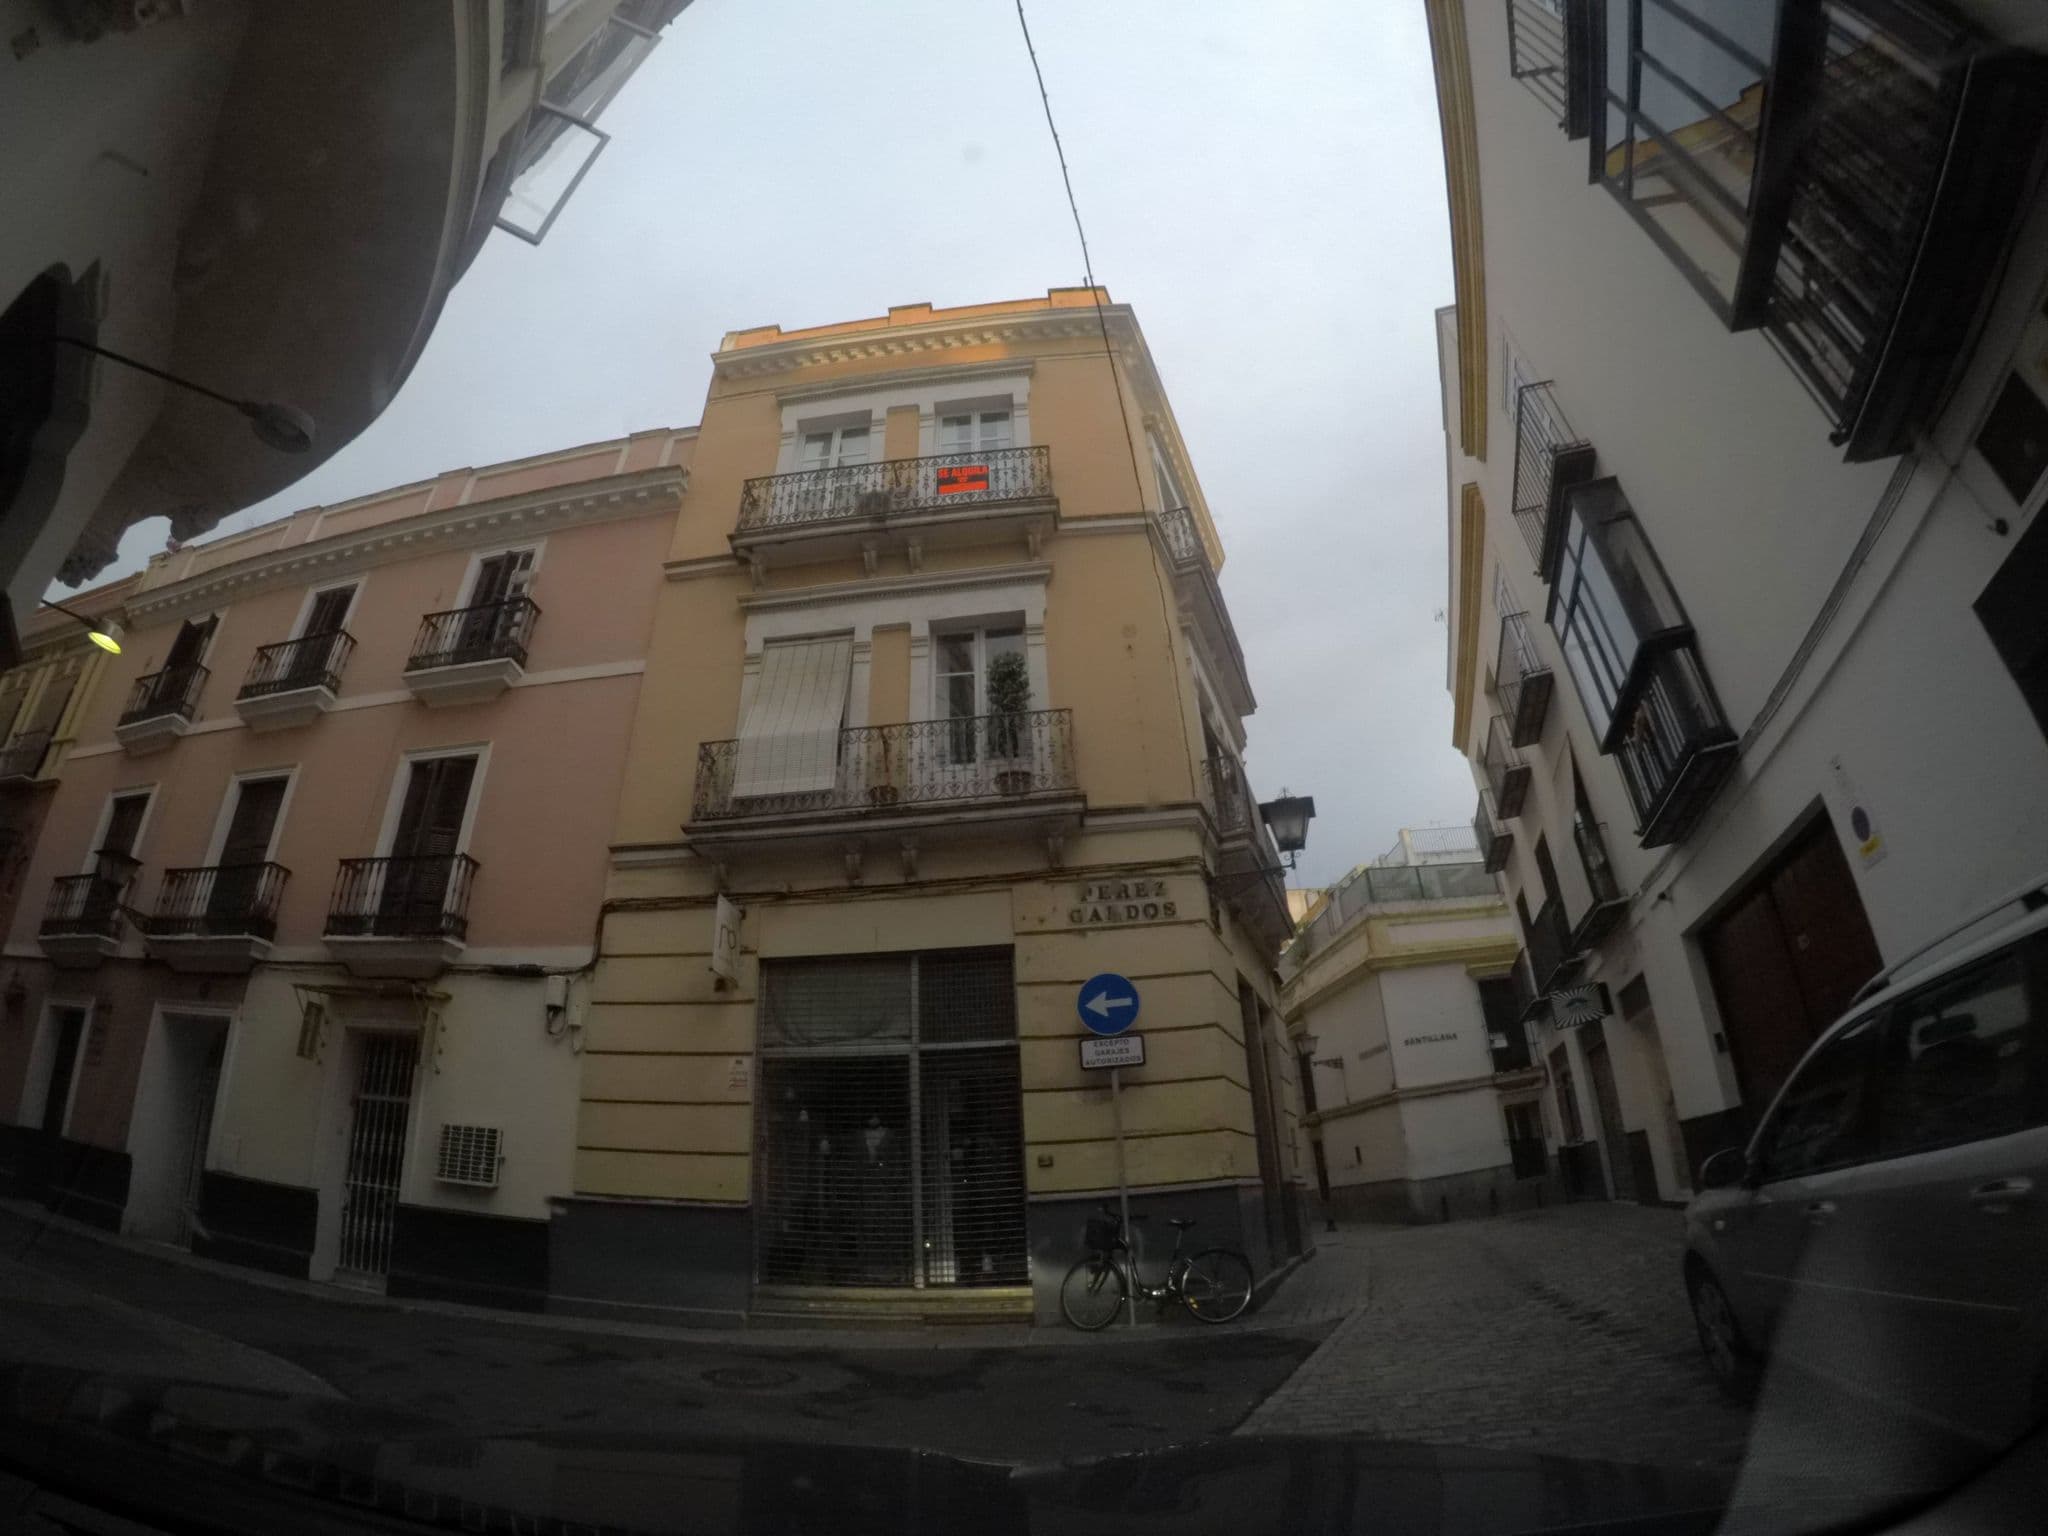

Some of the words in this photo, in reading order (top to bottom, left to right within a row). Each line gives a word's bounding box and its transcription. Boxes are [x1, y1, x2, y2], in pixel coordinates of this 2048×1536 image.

[1070, 902, 1177, 923] GALDOS
[1093, 1039, 1129, 1048] EXCEPTO
[1404, 1033, 1458, 1046] SANTILLANA
[1094, 1048, 1130, 1056] GARAJES
[1085, 1055, 1142, 1065] AUTORIZADOS
